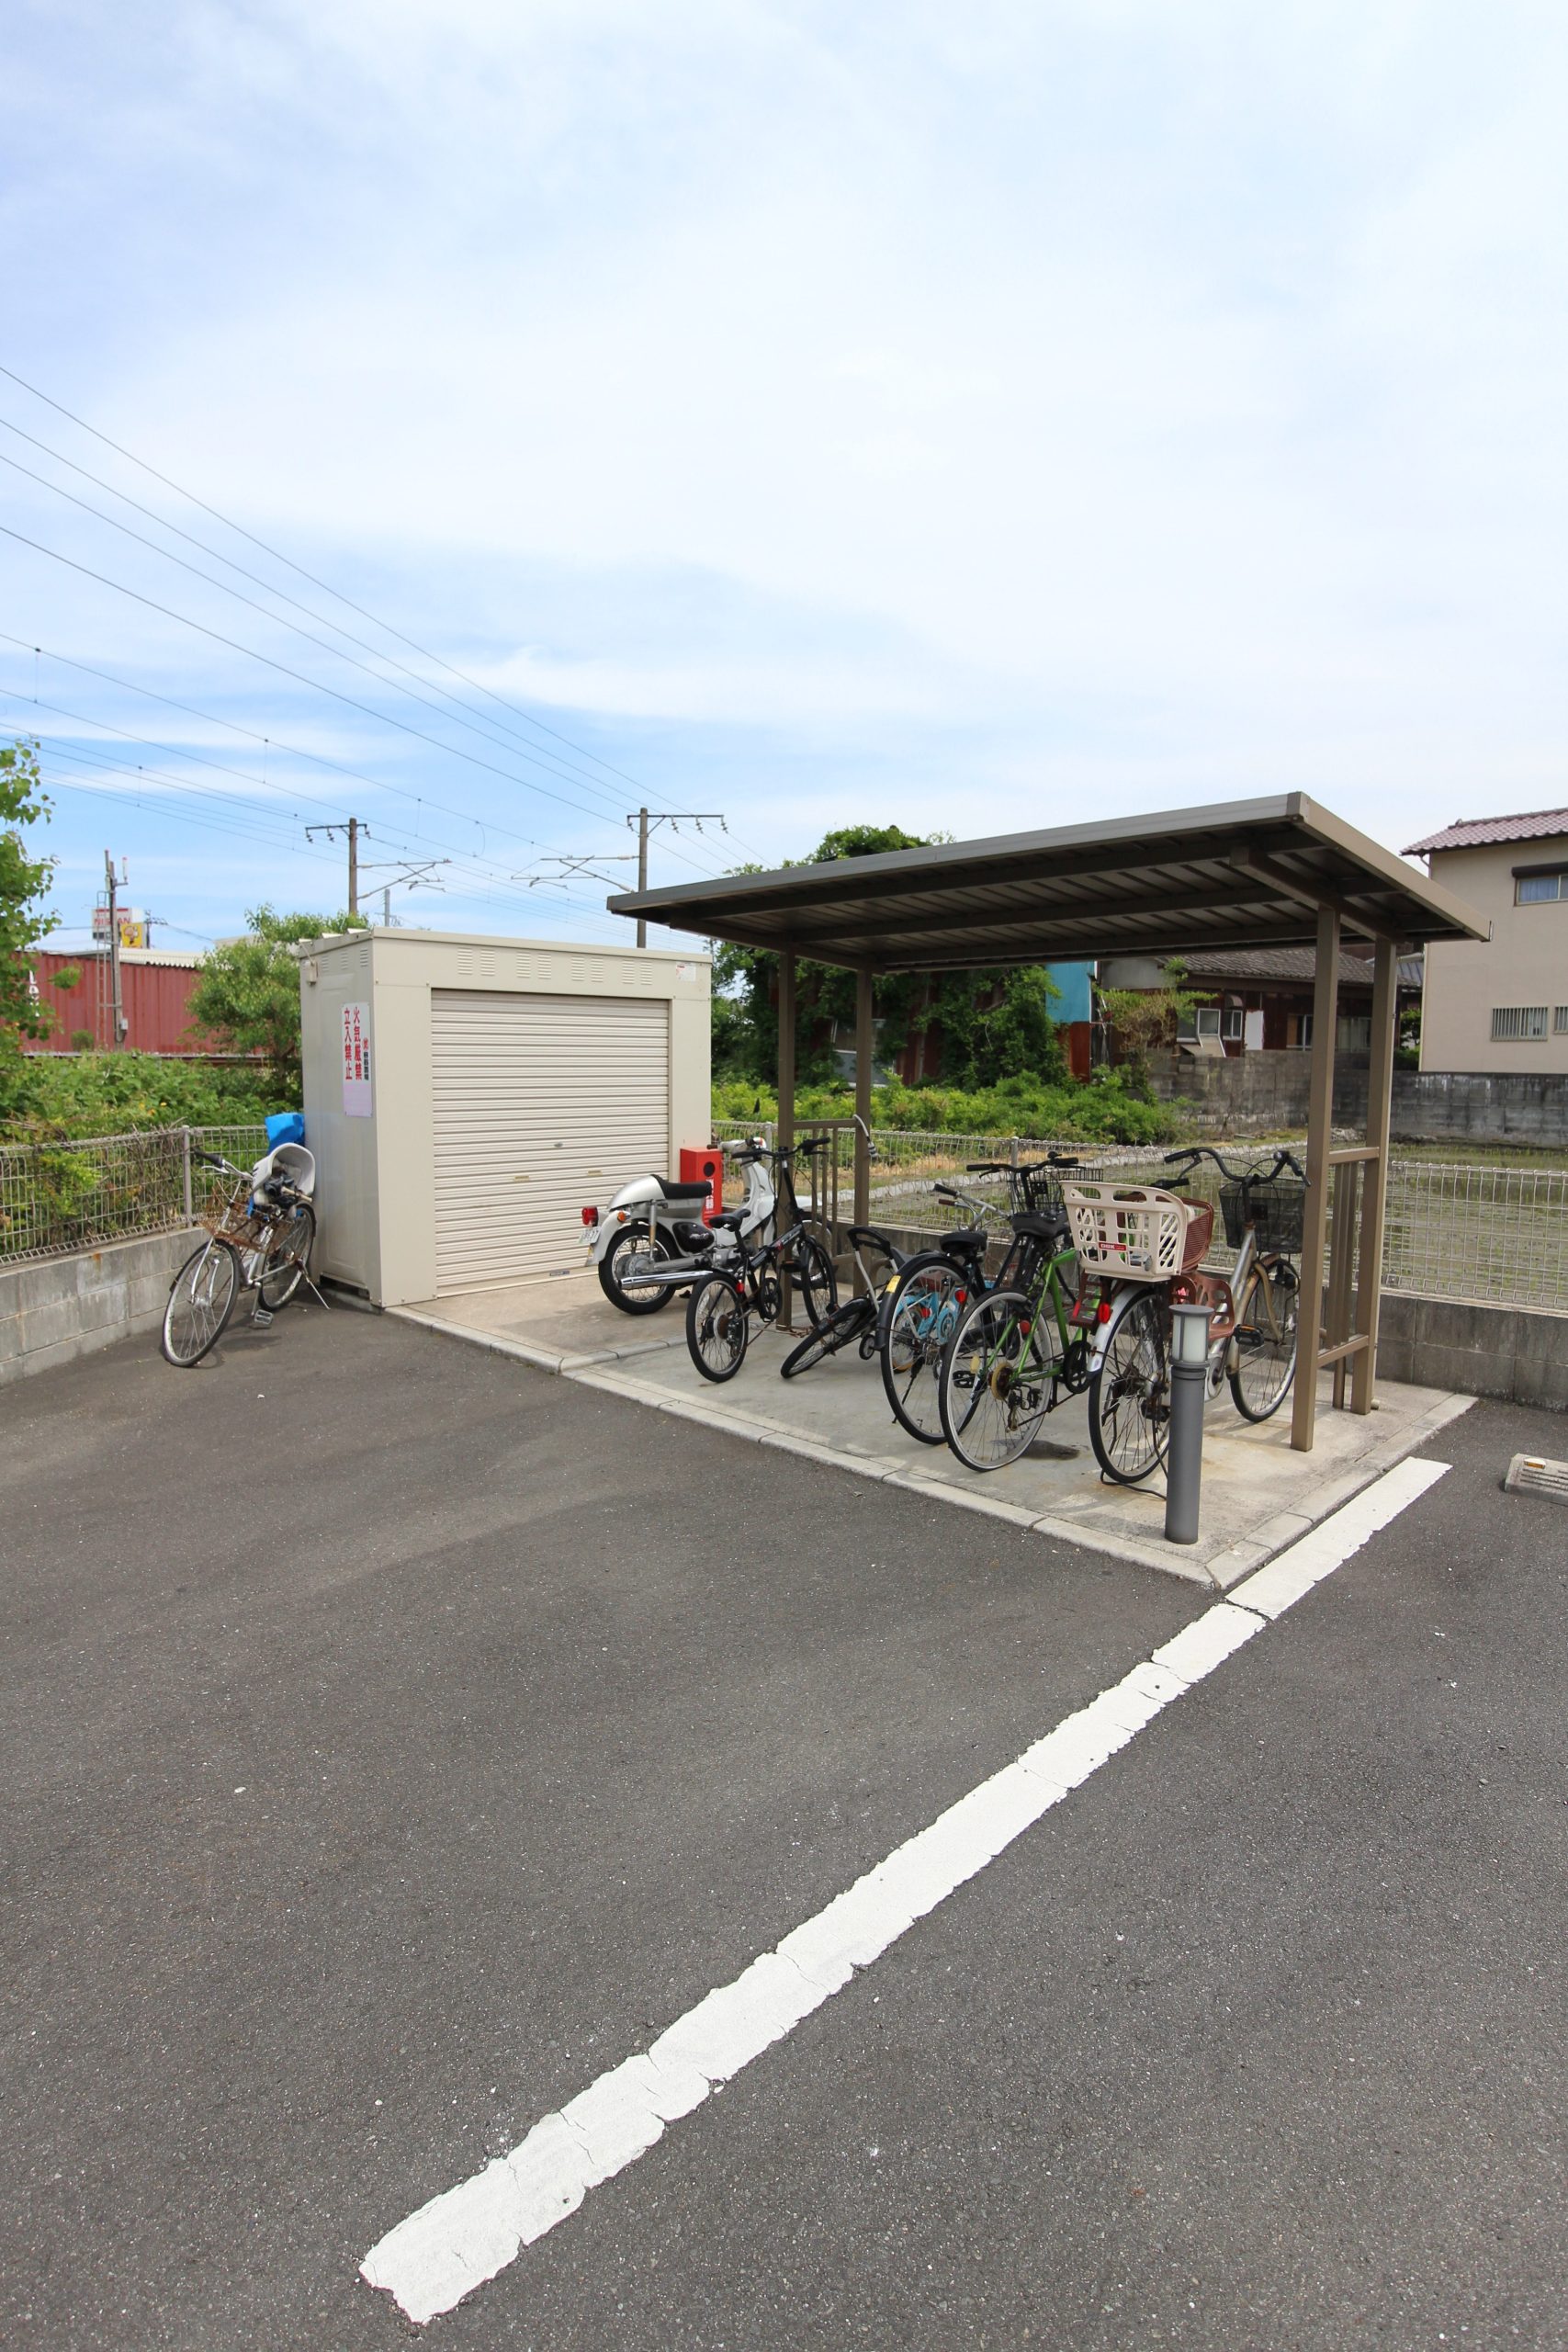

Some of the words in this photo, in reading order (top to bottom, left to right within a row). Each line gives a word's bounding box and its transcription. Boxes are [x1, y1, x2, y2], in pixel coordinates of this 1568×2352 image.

[95, 916, 130, 926] NISAN
[344, 1007, 353, 1080] 立入禁止
[354, 1006, 362, 1080] 火気厳禁
